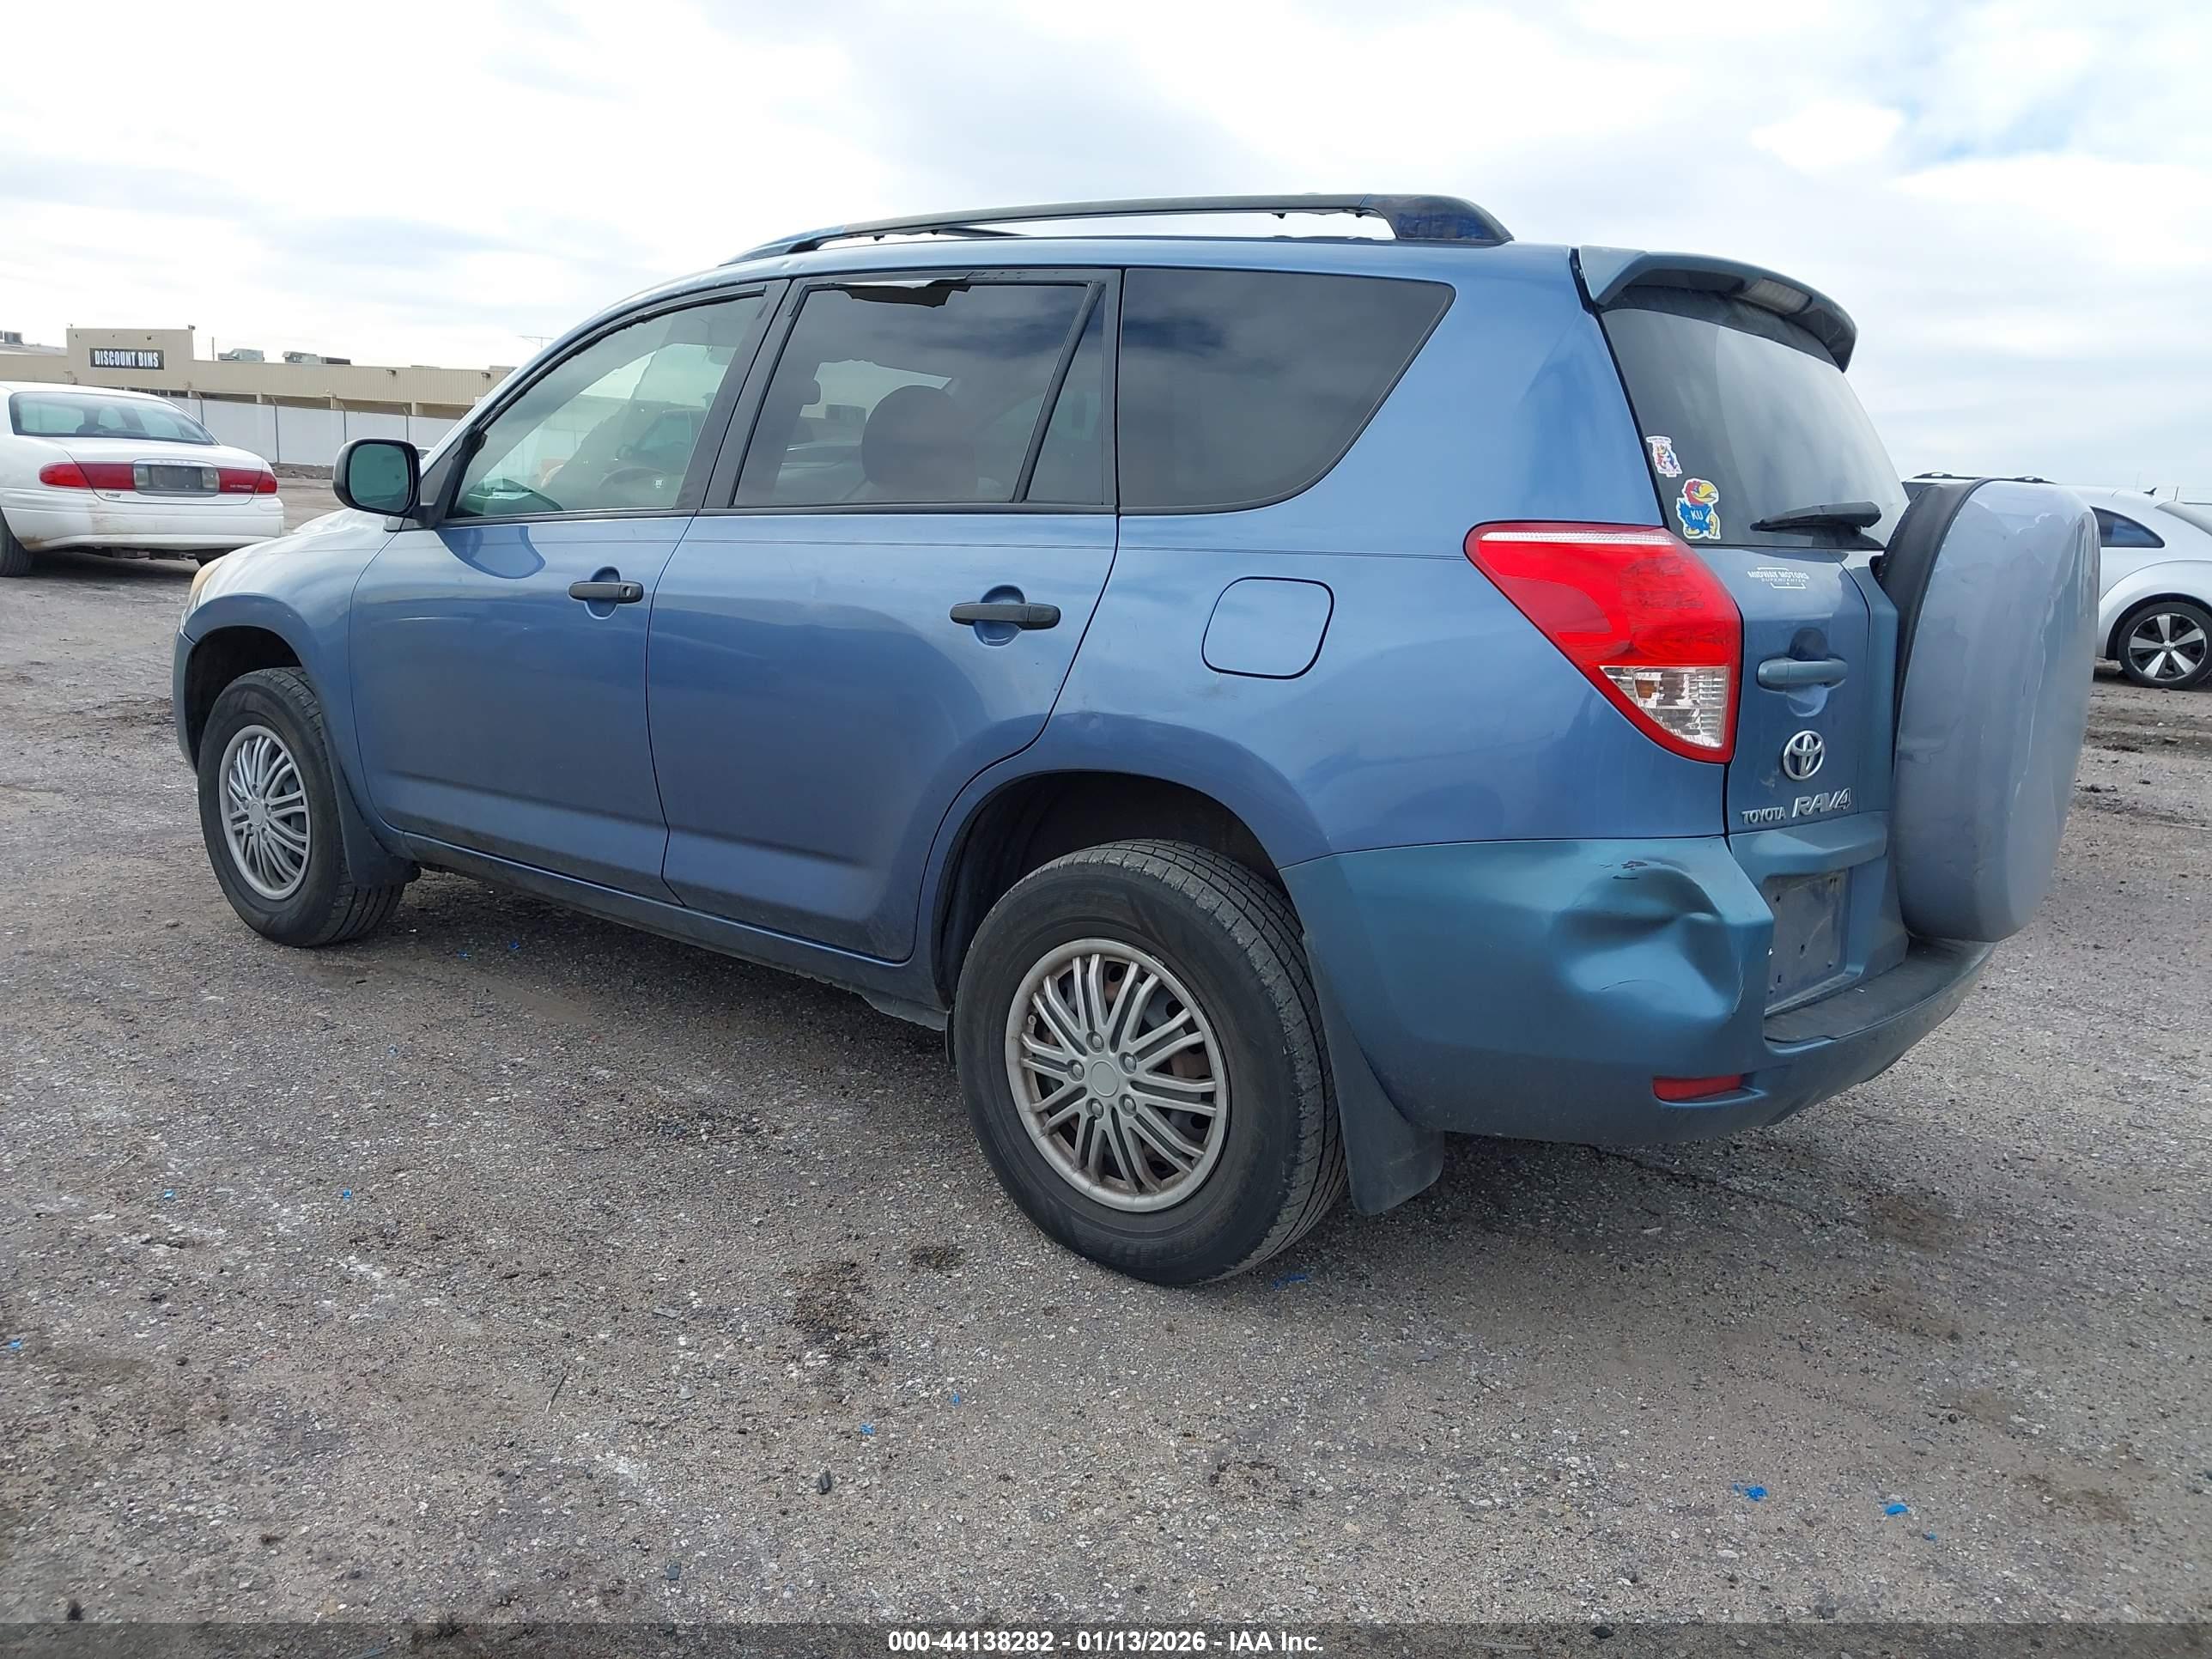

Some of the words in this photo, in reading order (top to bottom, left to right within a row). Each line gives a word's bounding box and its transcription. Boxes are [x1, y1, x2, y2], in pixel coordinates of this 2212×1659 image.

[94, 350, 136, 366] DISCOUNT
[138, 352, 158, 368] BINS
[1690, 509, 1704, 520] KU
[1778, 571, 1809, 580] MOTORS
[1741, 806, 1786, 824] TOYOTA
[1791, 787, 1851, 818] RAV4
